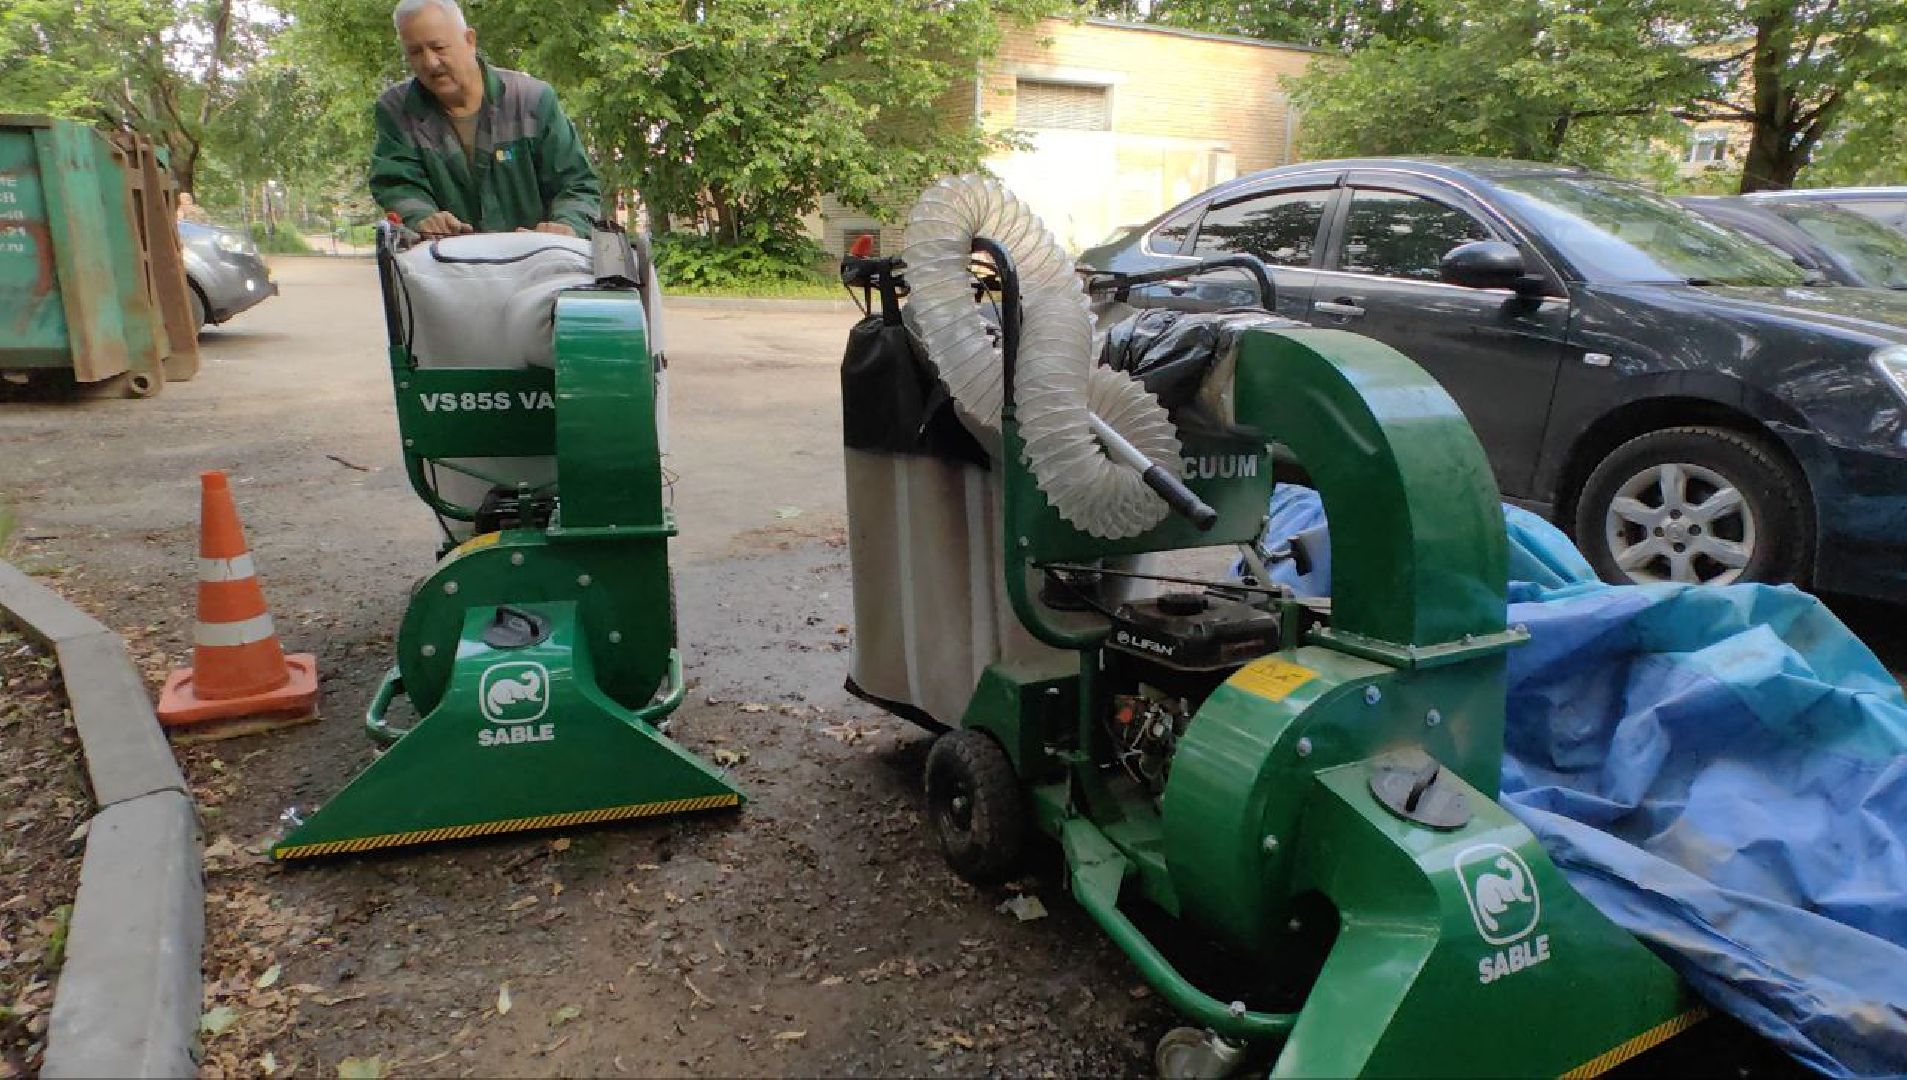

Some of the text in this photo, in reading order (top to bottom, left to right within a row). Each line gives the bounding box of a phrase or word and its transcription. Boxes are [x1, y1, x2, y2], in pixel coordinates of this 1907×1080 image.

[1181, 454, 1258, 479] CUUM
[1131, 636, 1173, 656] LIFAN
[478, 723, 555, 747] SABLE
[1478, 934, 1551, 984] SABLE
